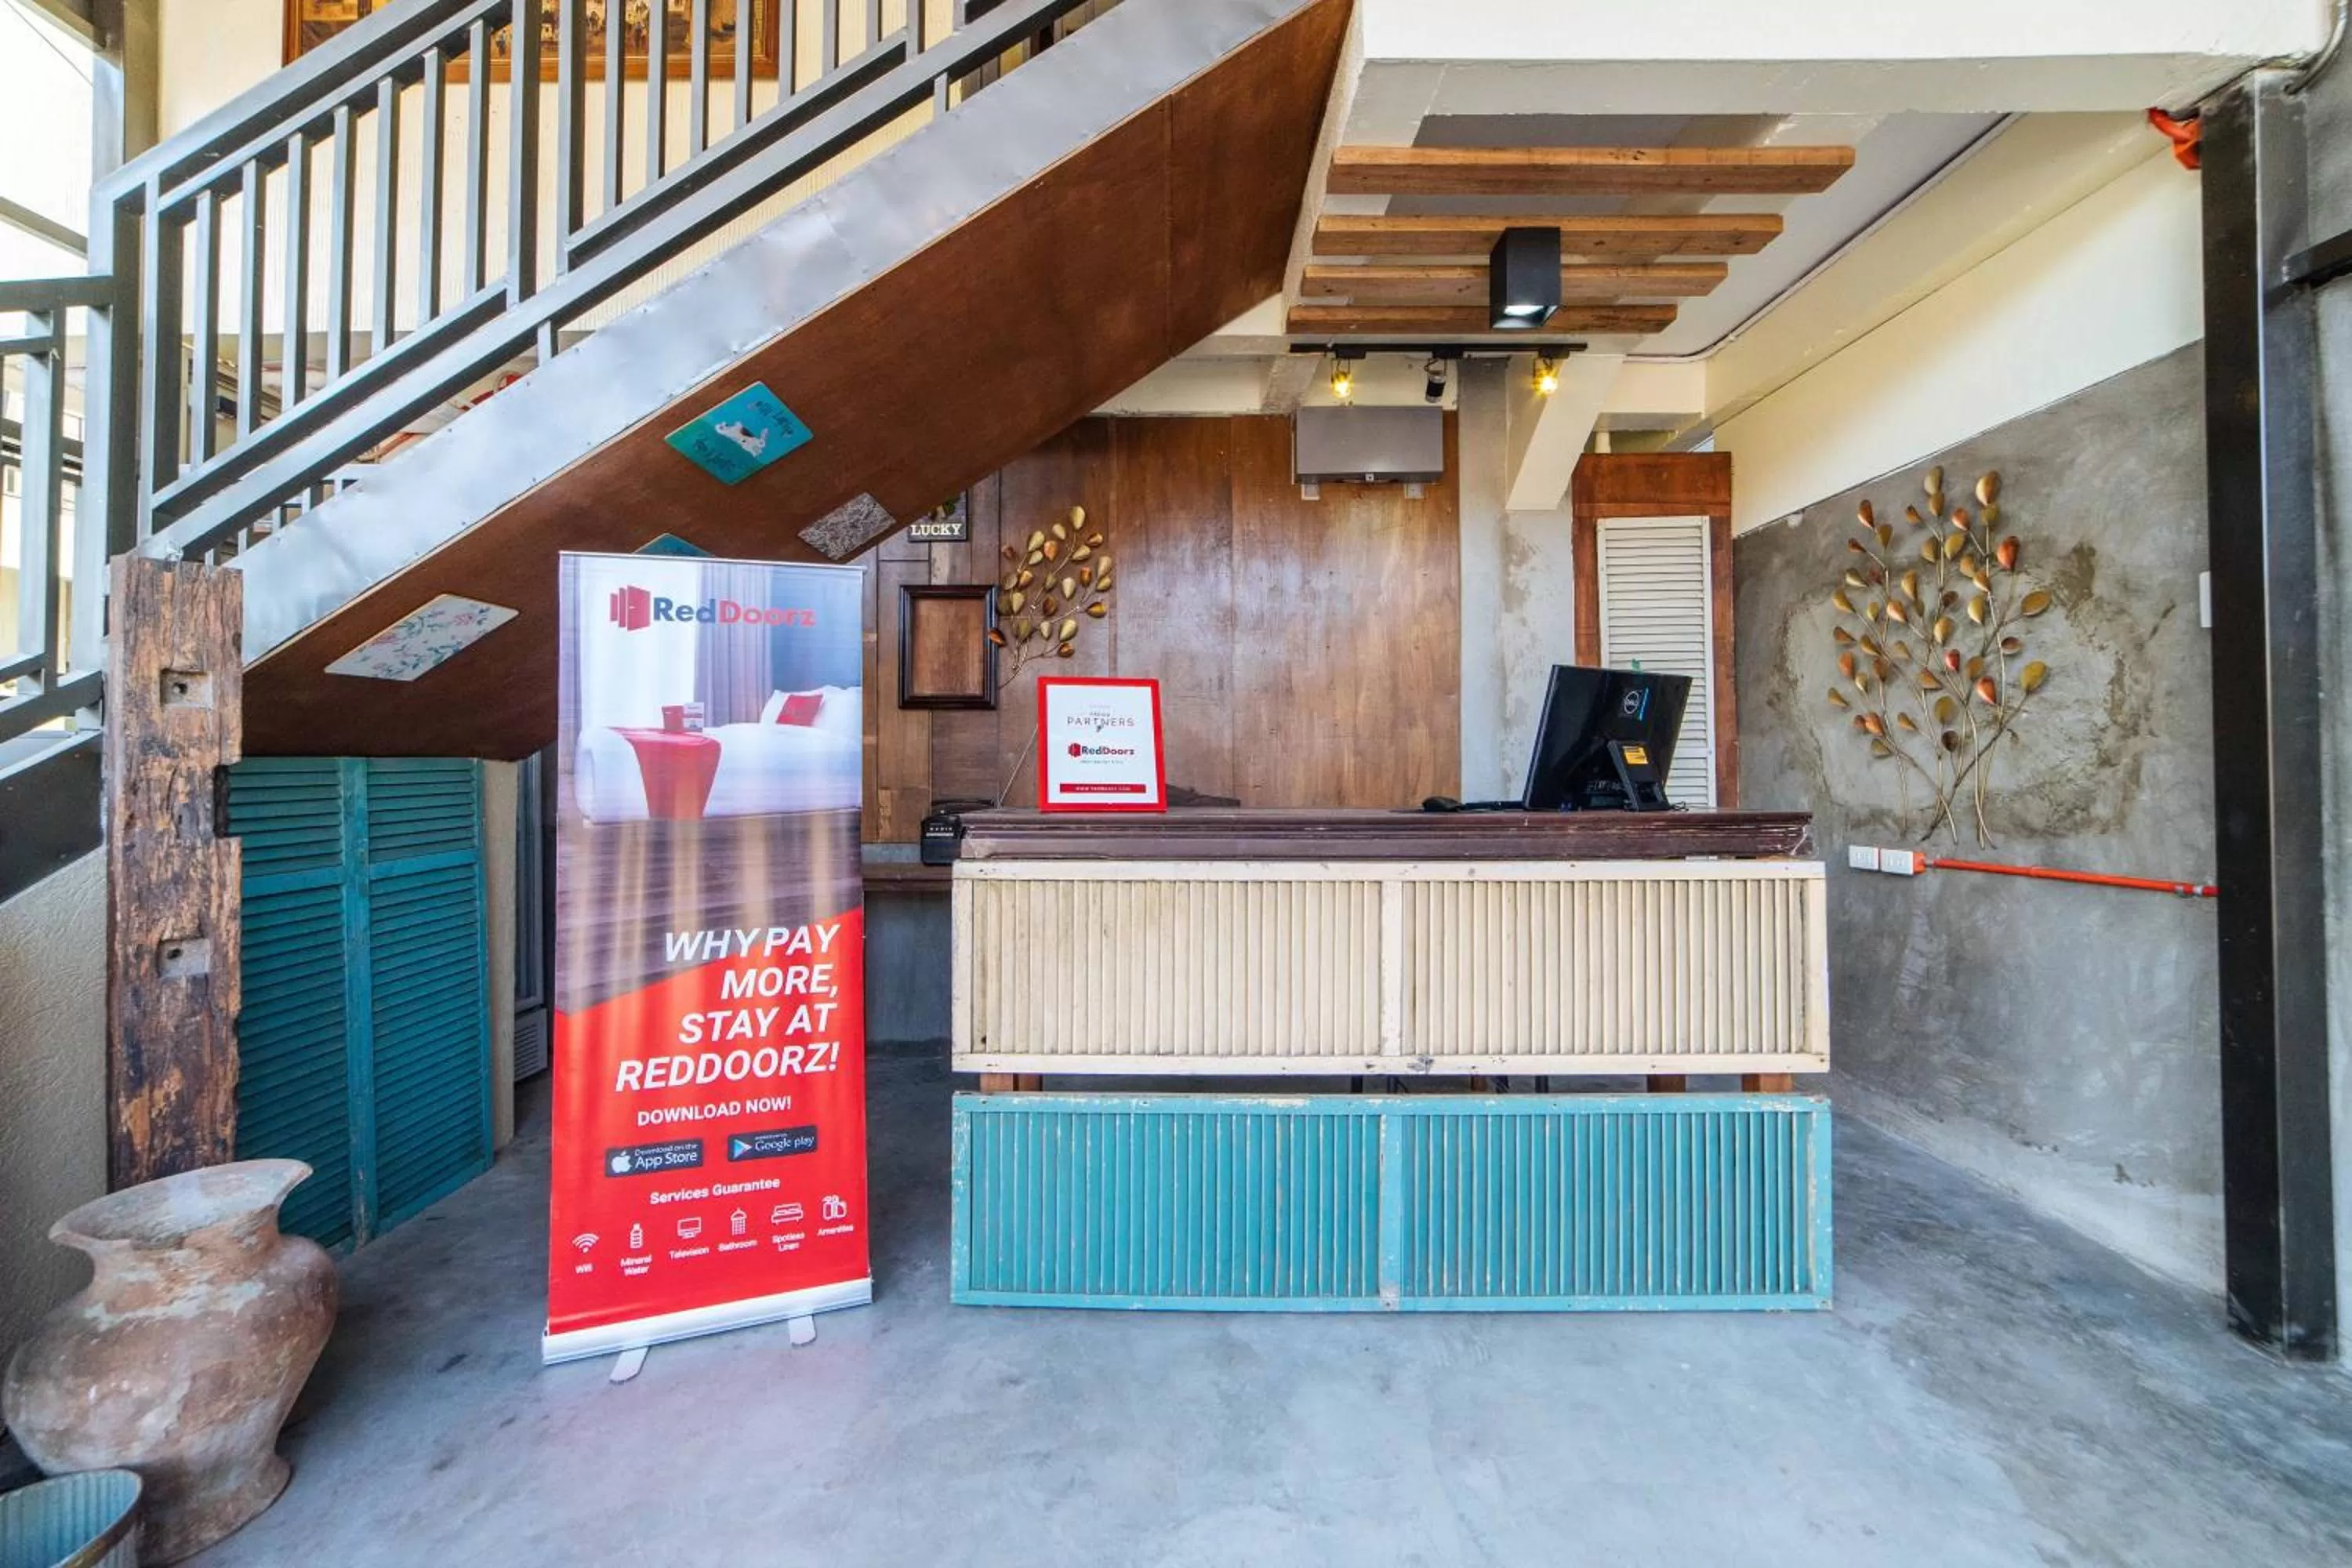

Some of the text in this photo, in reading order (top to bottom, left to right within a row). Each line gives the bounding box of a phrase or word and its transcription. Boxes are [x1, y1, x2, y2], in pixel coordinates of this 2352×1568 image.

[911, 523, 962, 535] LUCKY
[653, 597, 816, 626] RedDoorz
[1067, 716, 1135, 728] PARTNERS
[1081, 745, 1135, 756] RedDoorz
[666, 924, 840, 962] WHY PAY
[720, 964, 839, 1000] MORE,
[678, 1004, 838, 1044] STAY AT
[615, 1043, 840, 1093] REDDOORZ!
[637, 1097, 792, 1127] DOWNLOAD NOW!
[634, 1145, 673, 1156] Download
[754, 1138, 791, 1152] Google
[794, 1136, 815, 1149] play
[634, 1152, 697, 1170] App Store
[650, 1178, 780, 1205] Services Guarantee
[670, 1247, 710, 1260] Television
[718, 1240, 758, 1252] Bathroom
[620, 1254, 652, 1267] Mineral
[624, 1265, 649, 1276] Water
